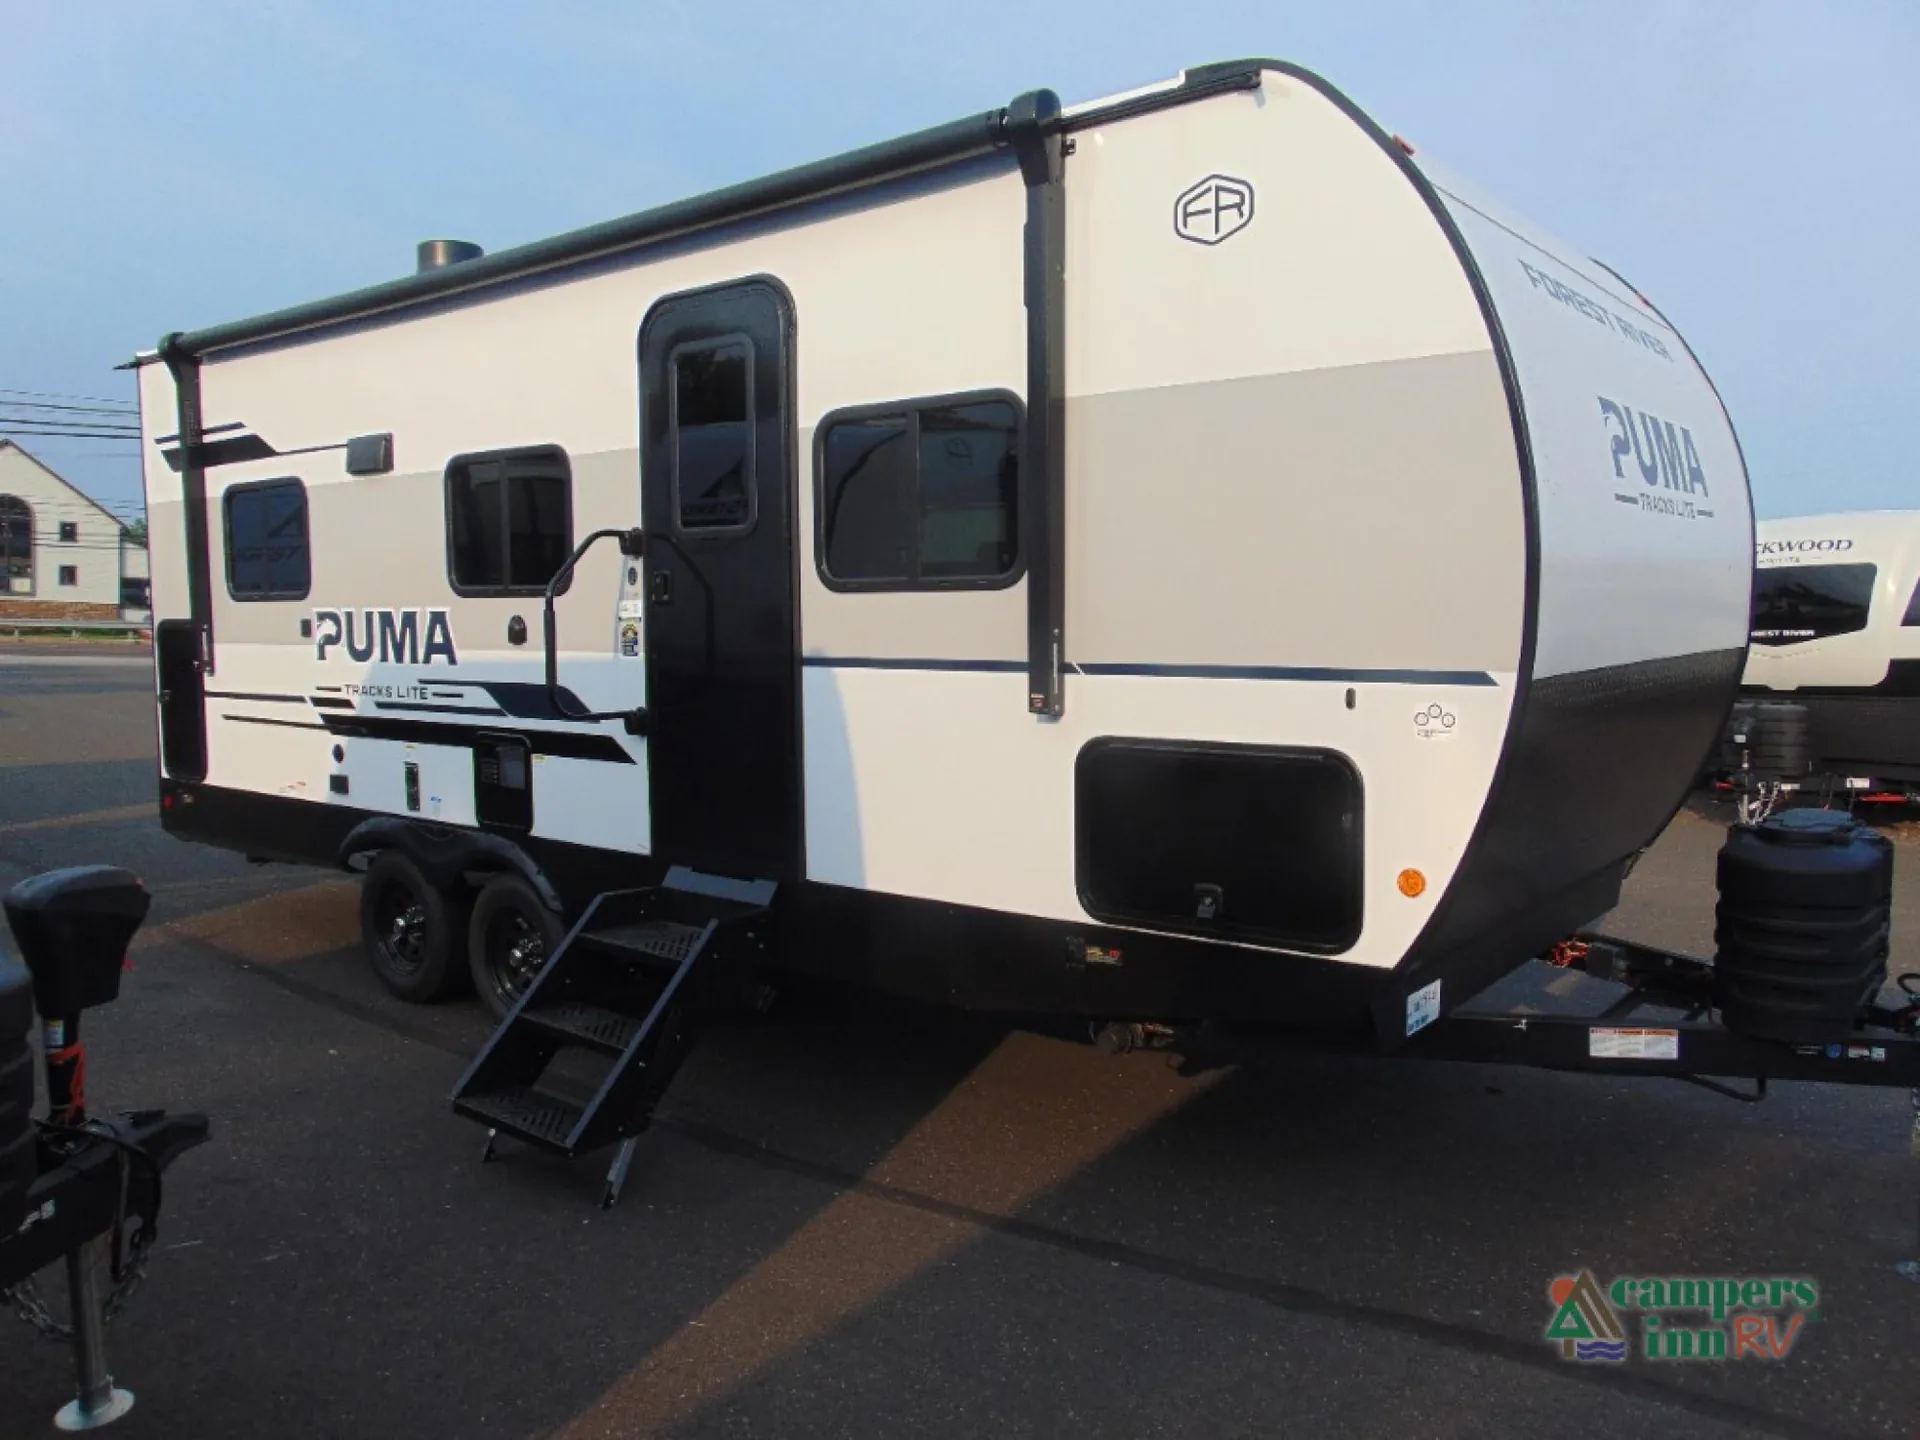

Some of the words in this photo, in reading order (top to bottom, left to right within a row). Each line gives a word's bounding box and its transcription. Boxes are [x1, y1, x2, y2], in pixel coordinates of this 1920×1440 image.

[1517, 258, 1616, 332] FOREST
[1611, 313, 1674, 363] RIVER
[1597, 395, 1709, 498] PUMA
[1640, 492, 1675, 516] TRACKS
[1676, 500, 1696, 519] LITE
[315, 609, 459, 666] PUMA
[345, 684, 393, 698] TRACKS
[397, 687, 429, 700] LITE
